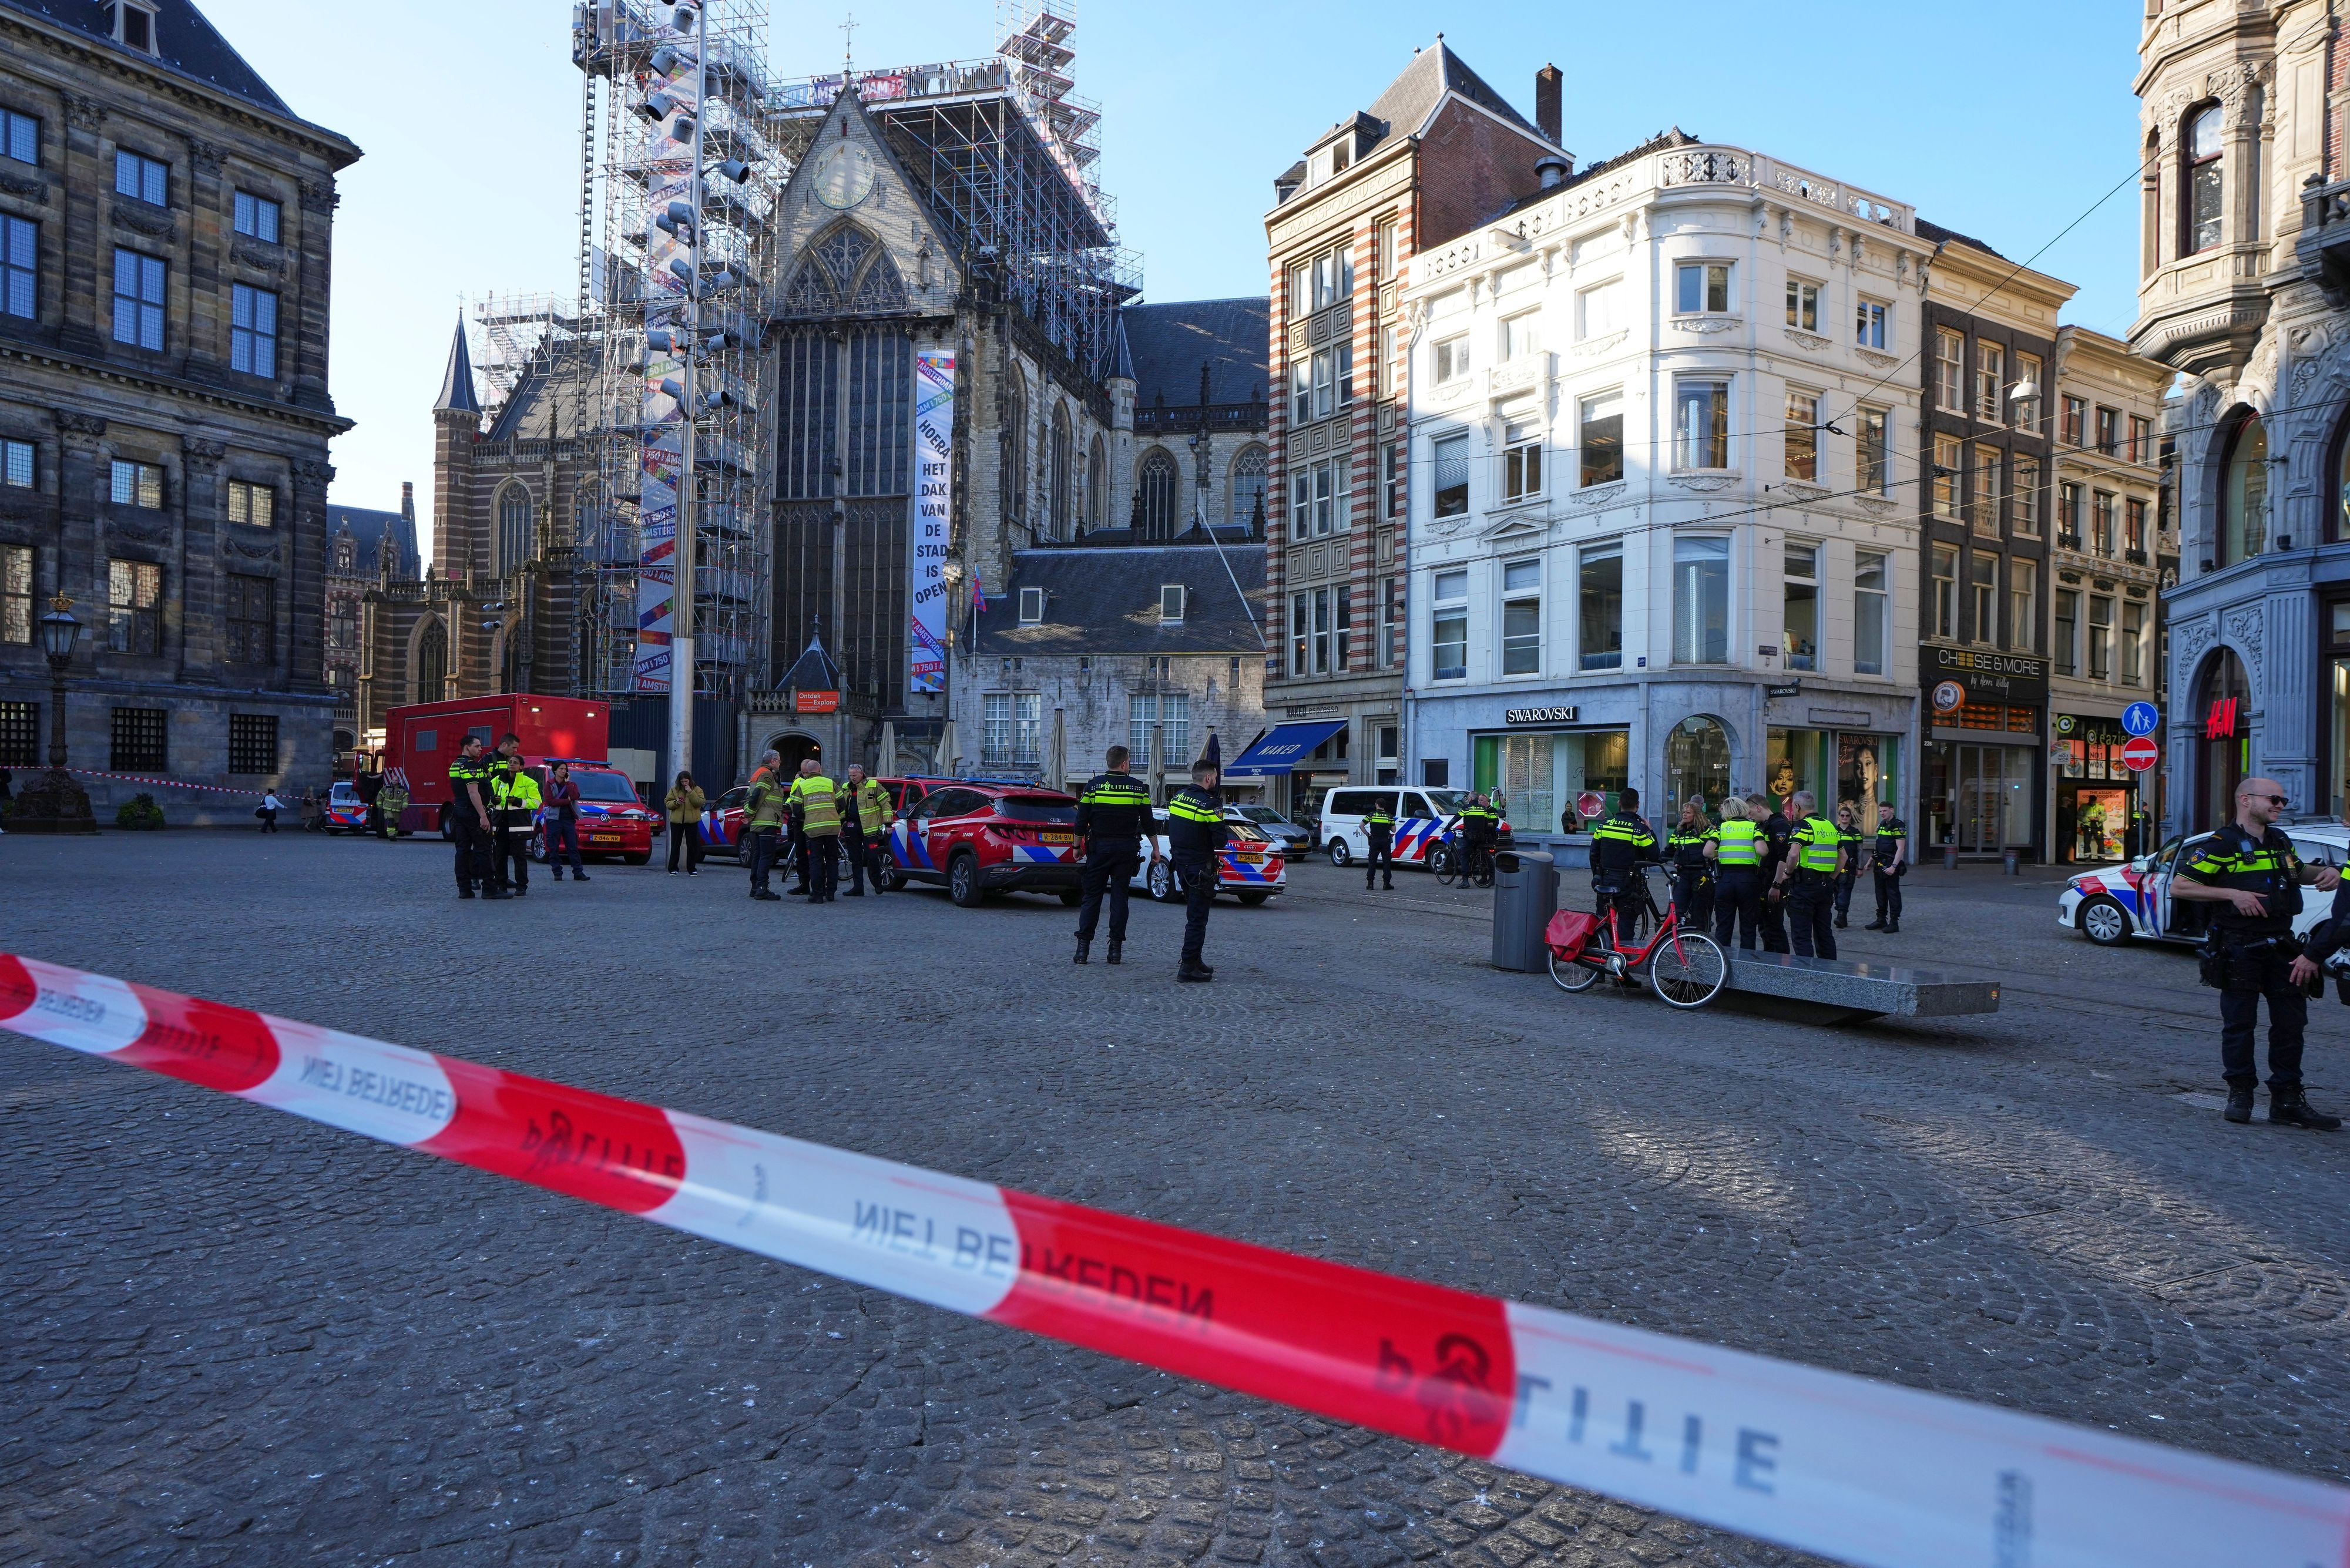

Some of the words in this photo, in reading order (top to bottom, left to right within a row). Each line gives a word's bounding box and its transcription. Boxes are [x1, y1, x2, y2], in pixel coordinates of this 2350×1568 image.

[918, 362, 954, 392] AMSTERDAM
[934, 394, 947, 405] 750
[918, 419, 951, 459] HOERA
[923, 463, 946, 476] HET
[921, 483, 946, 496] DAK
[921, 503, 945, 517] VAN
[925, 524, 941, 537] DE
[916, 545, 948, 558] STAD
[926, 565, 938, 577] IS
[915, 580, 947, 604] OPEN
[653, 654, 668, 667] 750
[921, 662, 933, 671] 750
[1994, 656, 2002, 671] &
[2004, 658, 2040, 676] MORE
[1970, 674, 1976, 689] by
[1980, 674, 1993, 687] Henri
[1286, 706, 1307, 718] NAKED
[1308, 705, 1338, 716] espresso
[1508, 707, 1573, 723] SWAROVSKI
[2207, 697, 2237, 740] H&M
[1838, 735, 1878, 746] SWAROVSKI
[2100, 731, 2126, 746] eazie
[1257, 744, 1301, 756] NAKED
[1100, 781, 1129, 791] POLITIE
[1606, 818, 1633, 827] POLITIE
[1721, 824, 1753, 834] POLITIE
[1817, 828, 1838, 838] POLITIE
